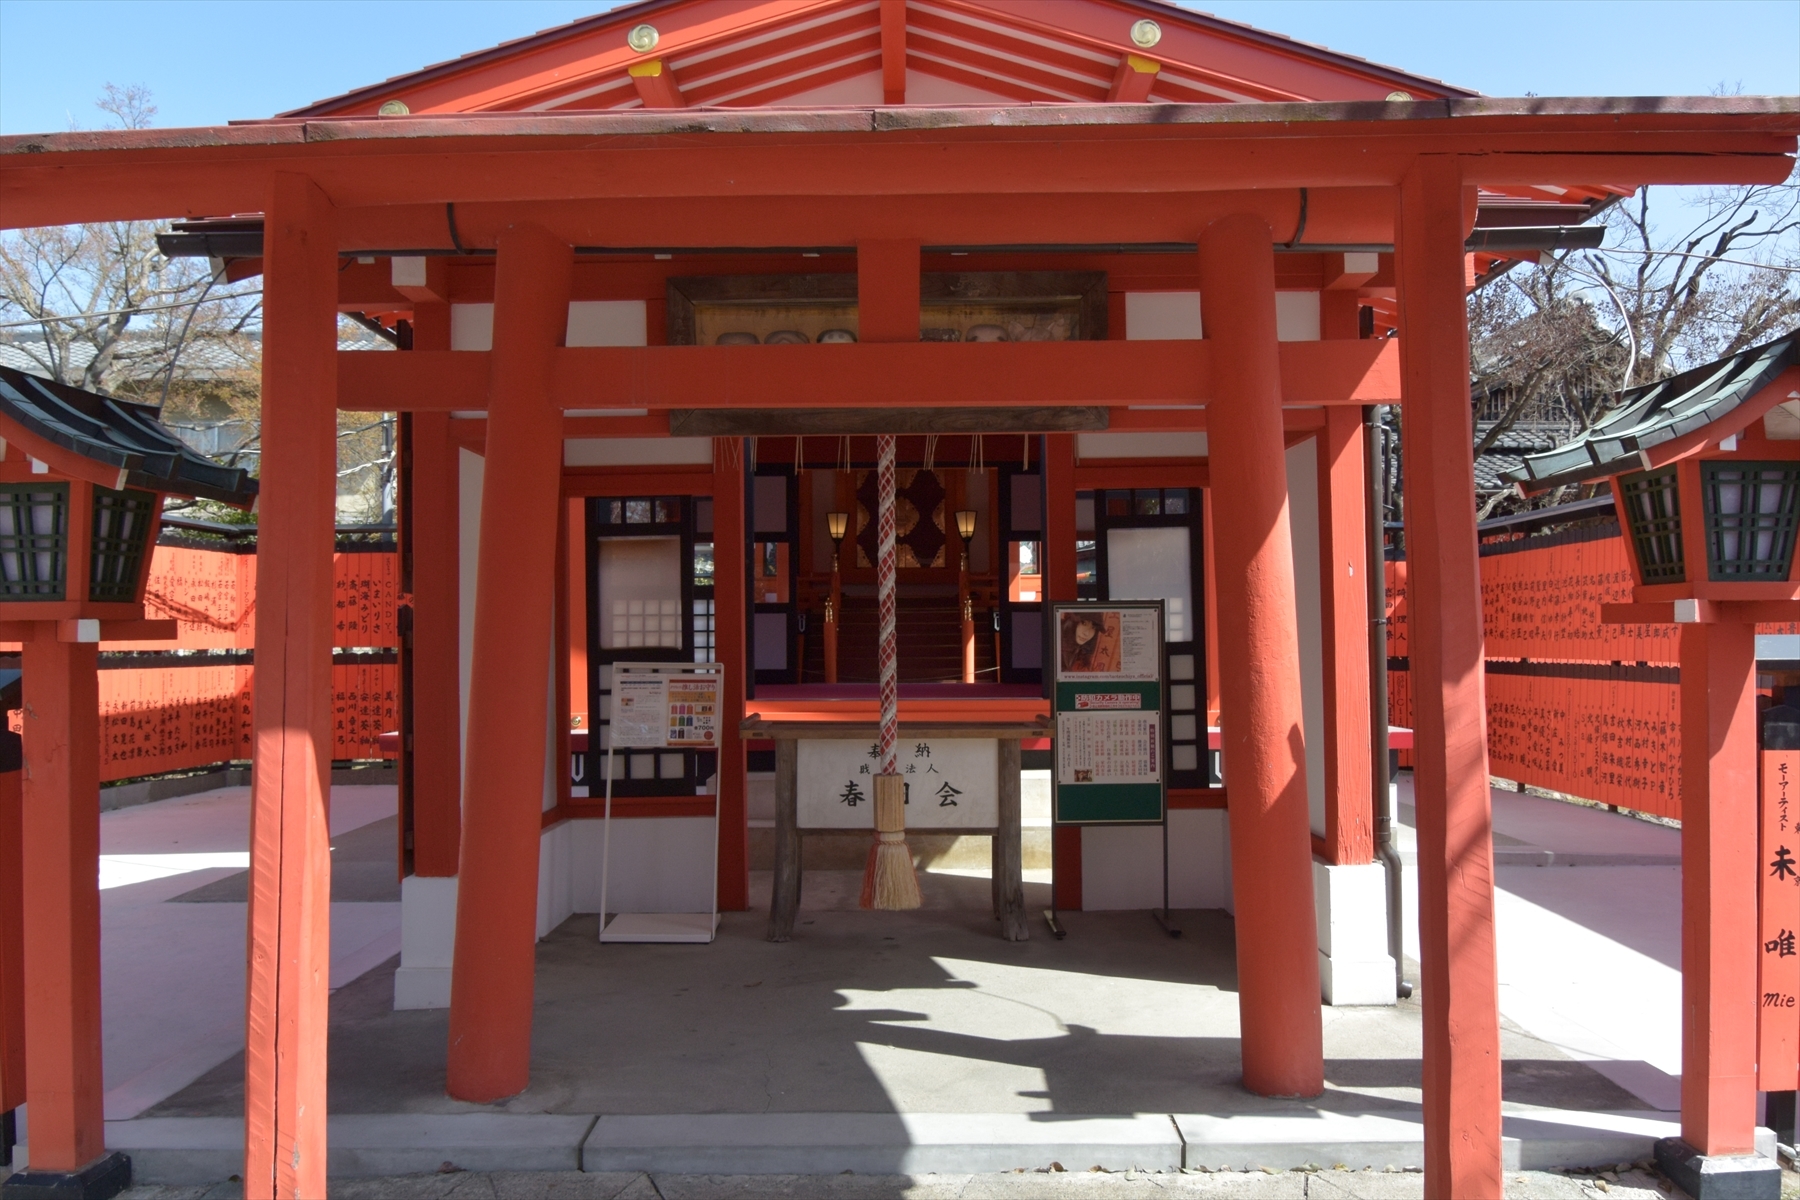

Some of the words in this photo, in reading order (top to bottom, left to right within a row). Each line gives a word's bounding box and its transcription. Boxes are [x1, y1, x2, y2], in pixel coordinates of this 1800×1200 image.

[372, 580, 381, 634] いまいりさ
[336, 691, 345, 745] 福田真弓
[859, 763, 939, 775] 財法人
[839, 780, 963, 807] 春会
